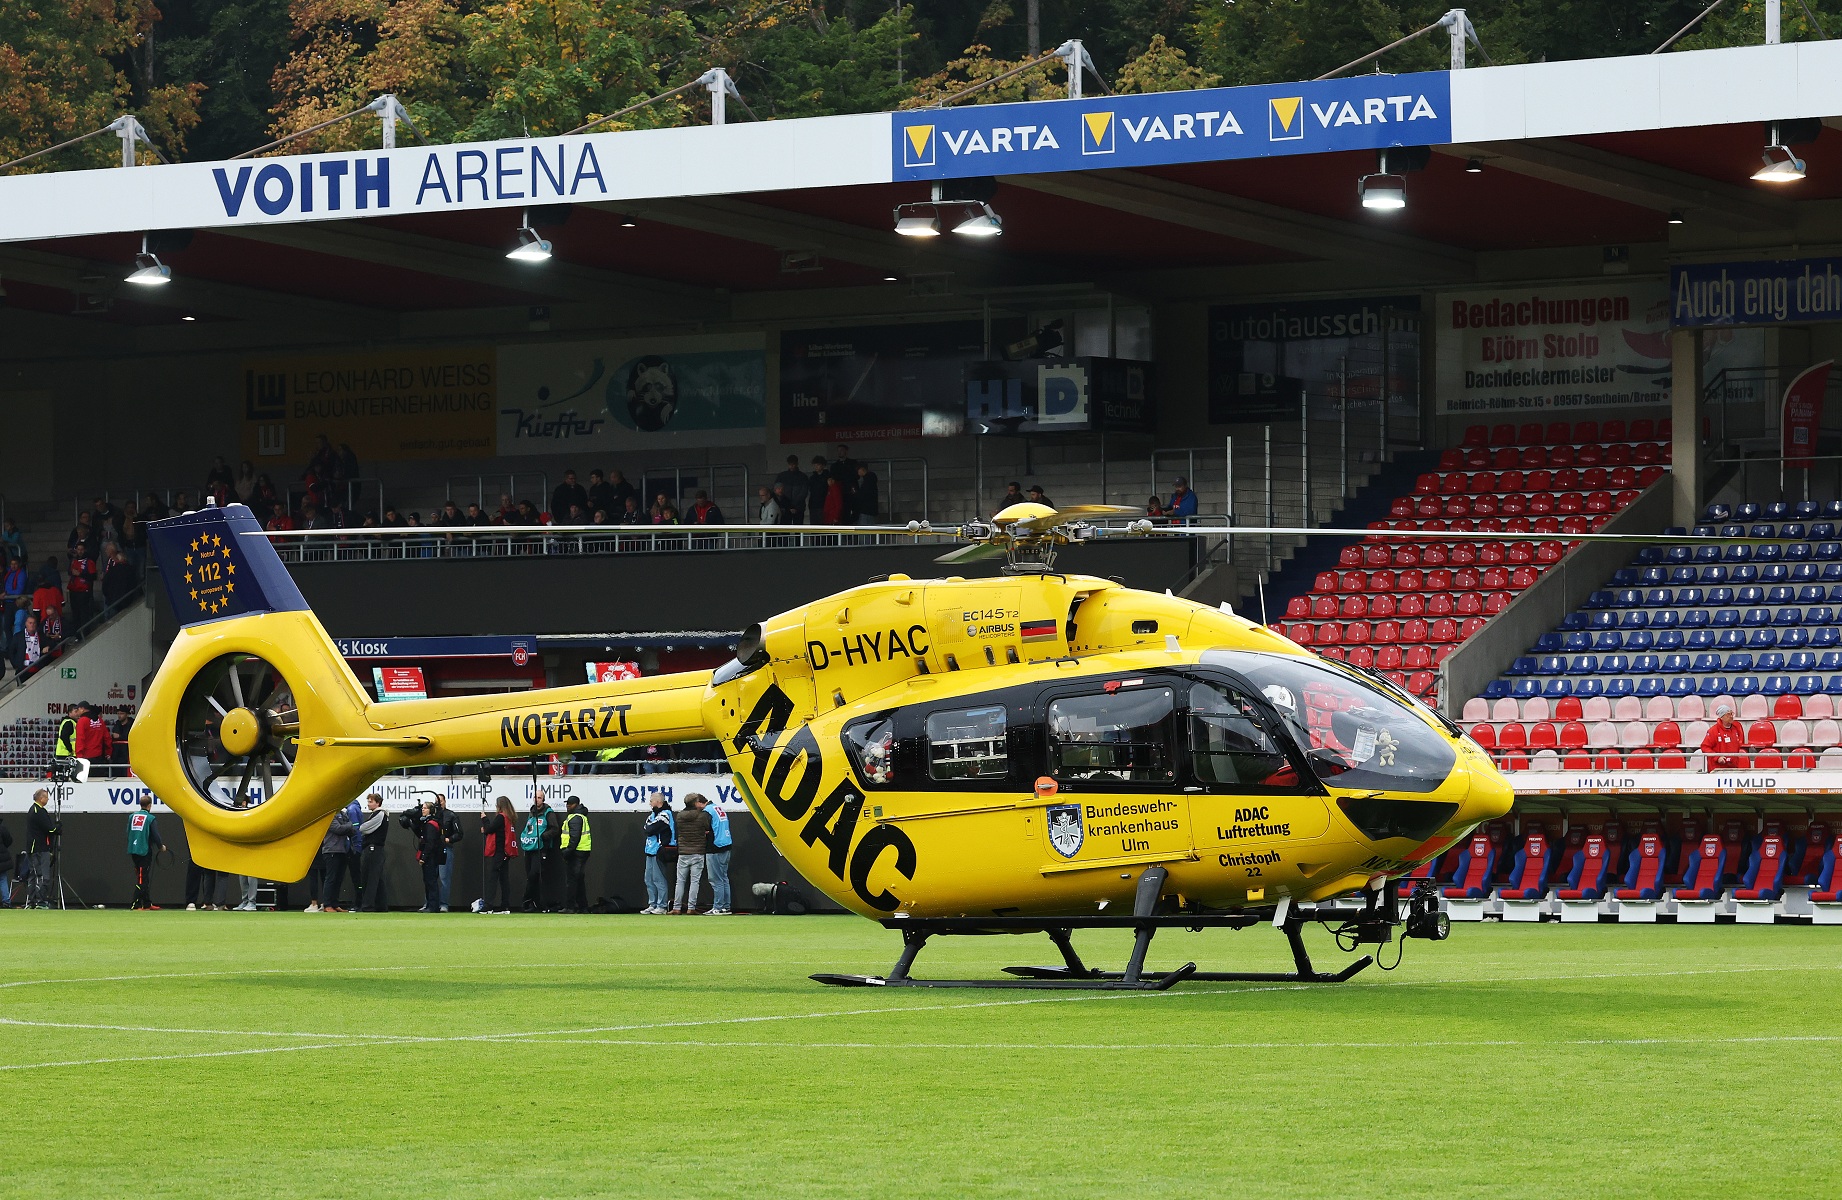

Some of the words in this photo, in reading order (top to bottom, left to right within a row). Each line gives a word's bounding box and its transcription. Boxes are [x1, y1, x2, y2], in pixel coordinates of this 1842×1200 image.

[1309, 94, 1438, 129] VARTA
[1121, 109, 1244, 142] VARTA
[941, 125, 1060, 156] VARTA
[212, 156, 390, 217] VOITH
[415, 142, 608, 206] ARENA
[1611, 247, 1619, 257] N
[1675, 268, 1735, 319] Auch
[1744, 276, 1788, 321] eng
[1453, 297, 1630, 329] Bedachungen
[1482, 336, 1539, 363] Björn
[1543, 333, 1600, 360] Stolp
[293, 367, 414, 395] LEONHARD
[420, 363, 491, 389] WEISS
[1465, 365, 1618, 389] Dachdeckermeister
[294, 392, 491, 419] BAUUNTERNEHMUNG
[793, 393, 818, 407] liha
[1554, 393, 1584, 408] 89567
[1102, 400, 1141, 418] Technik
[501, 408, 605, 439] Kieffer
[836, 429, 885, 439] FULL-SERVICE
[886, 427, 901, 437] FÜR
[903, 427, 921, 436] IHRE
[200, 549, 216, 558] Notruf
[198, 562, 222, 583] 112
[200, 585, 224, 594] europaweit
[978, 633, 1016, 643] HELICOPTERS
[979, 623, 1015, 636] AIRBUS
[807, 624, 930, 671] D-HYAC
[515, 653, 526, 661] FCH
[48, 703, 61, 714] FCH
[501, 704, 632, 748] NOTARZT
[387, 785, 417, 799] MHP
[462, 784, 493, 799] MHP
[541, 784, 572, 799] MHP
[733, 682, 917, 911] ADAC
[1086, 799, 1178, 818] Bundeswehr-
[1235, 806, 1269, 823] ADAC
[1088, 819, 1179, 836] krankenhaus
[1217, 823, 1291, 840] Luftrettung
[1122, 839, 1150, 852] Ulm
[1218, 850, 1281, 866] Christoph
[1245, 867, 1263, 877] 22
